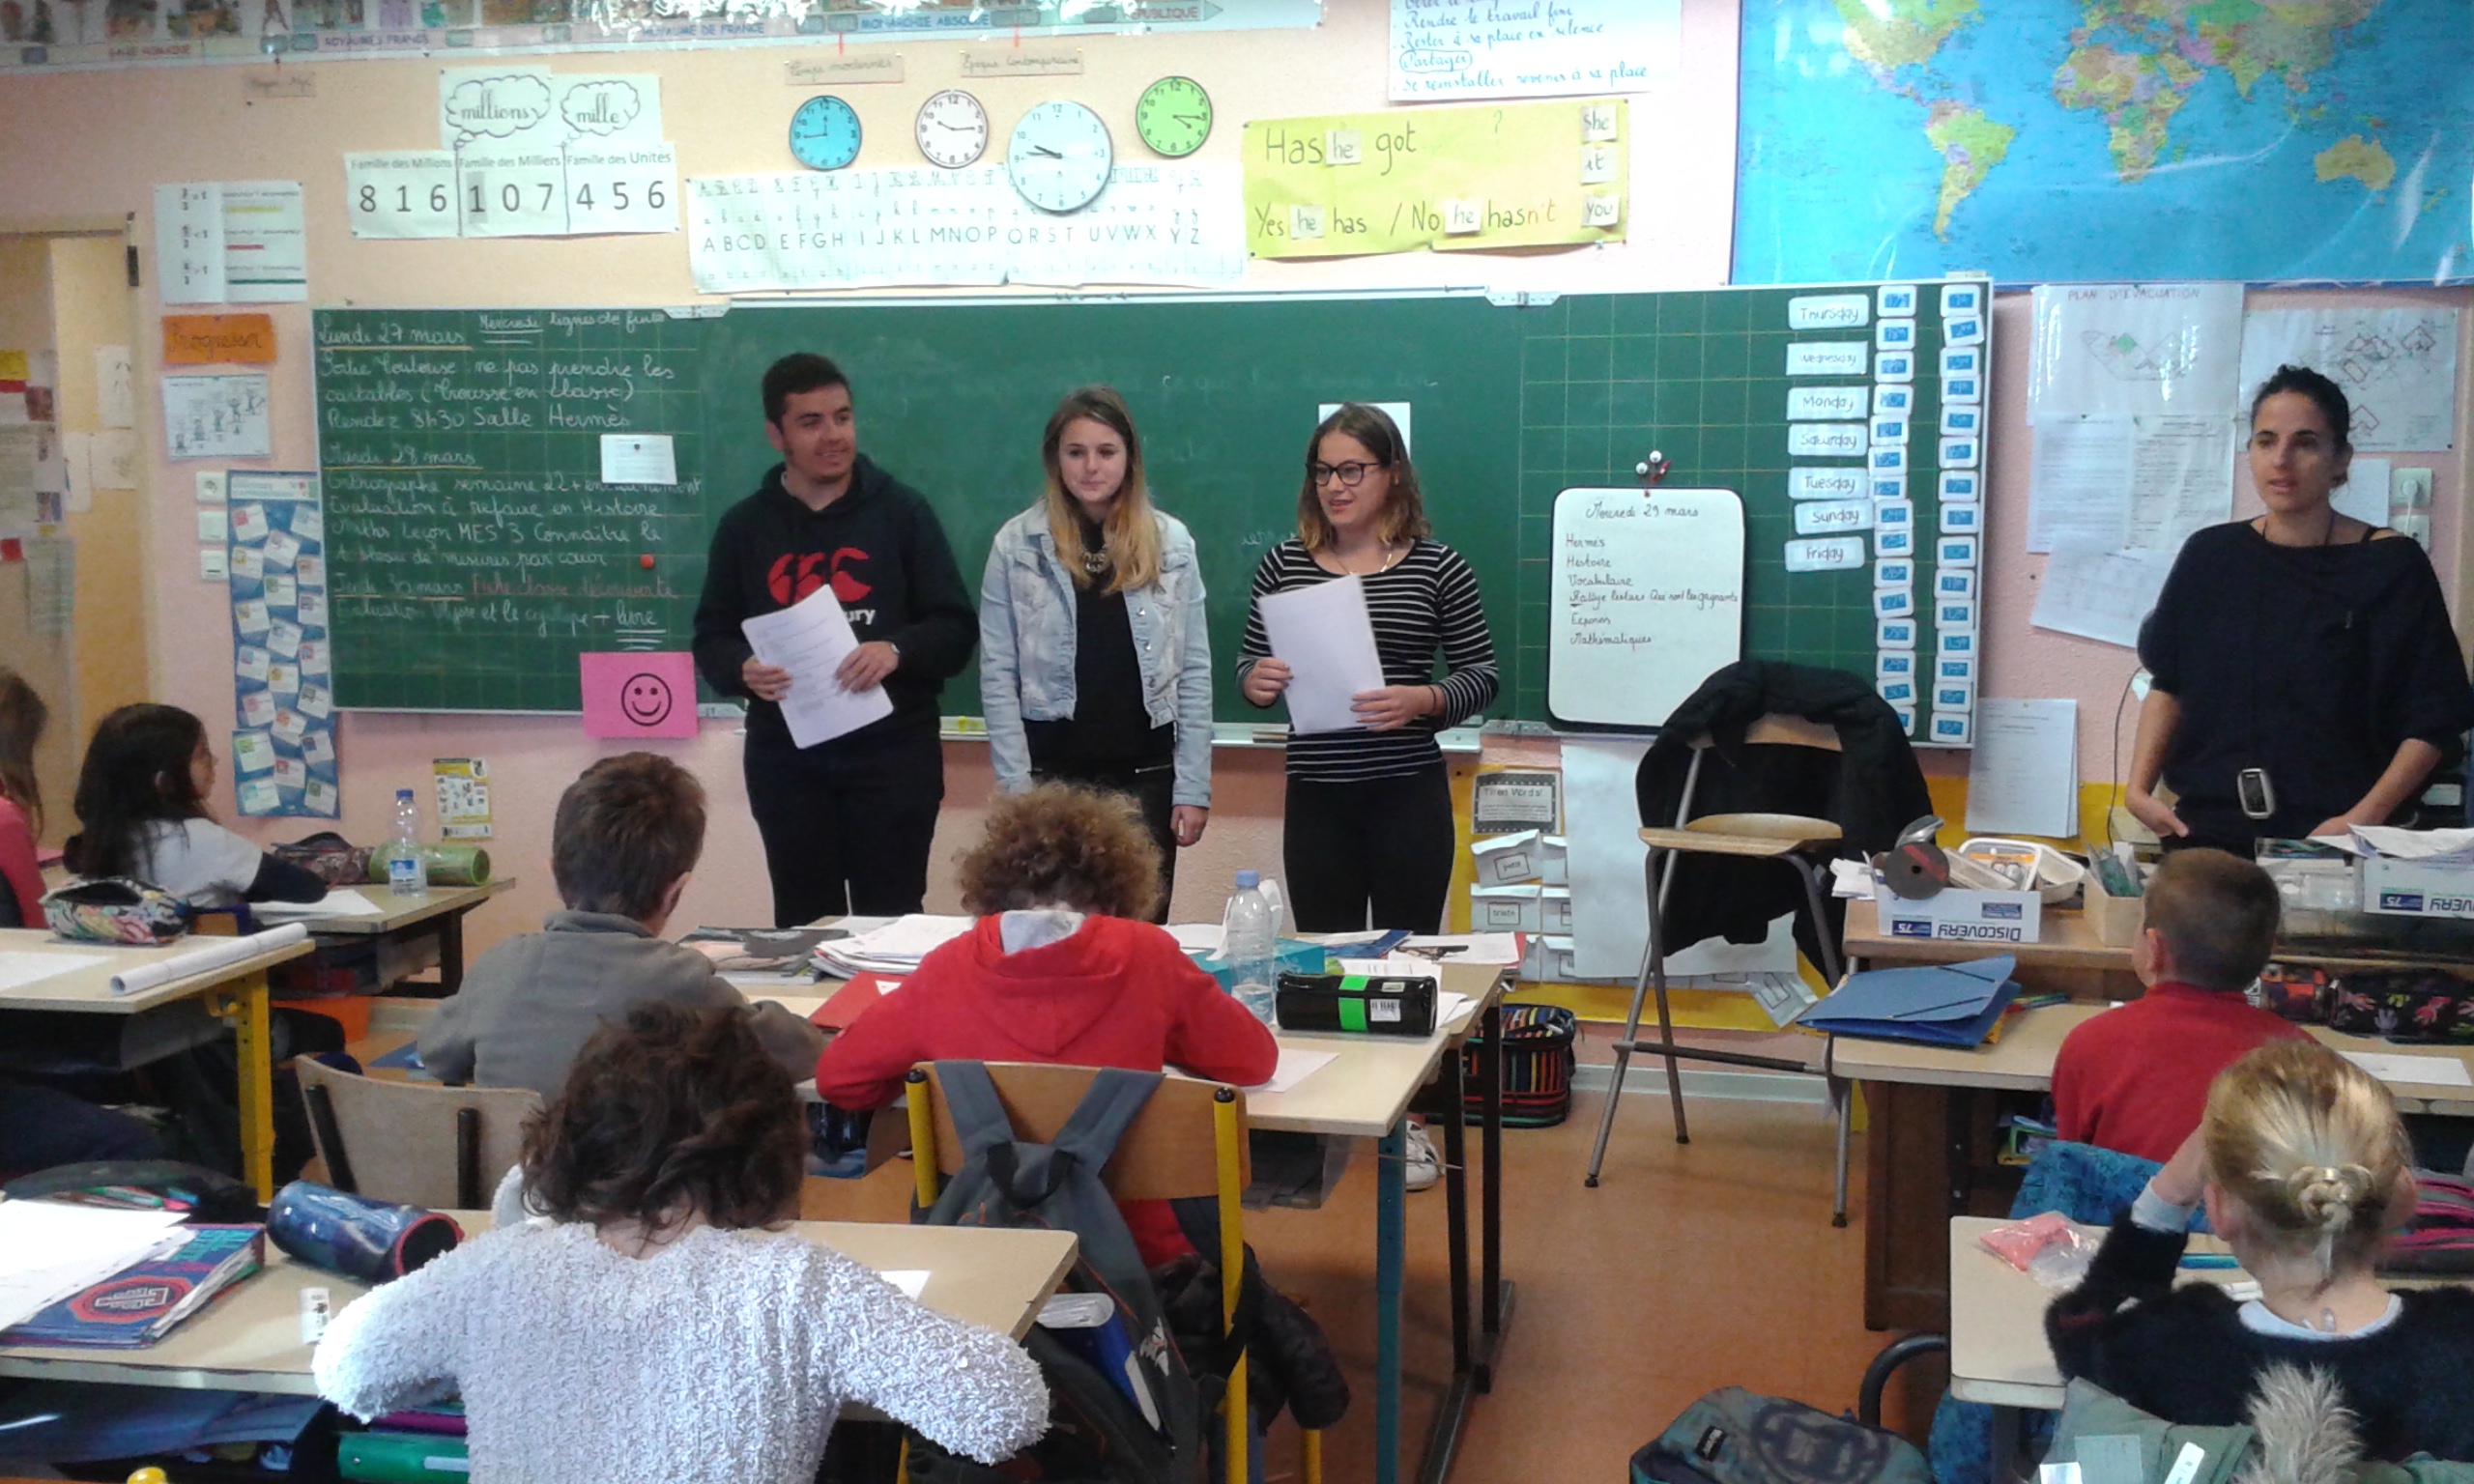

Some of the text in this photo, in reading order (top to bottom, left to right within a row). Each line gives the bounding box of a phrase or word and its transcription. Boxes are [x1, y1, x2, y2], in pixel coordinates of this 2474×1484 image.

[461, 90, 531, 122] millions
[576, 93, 620, 125] mille
[1583, 111, 1611, 132] she
[1264, 127, 1324, 166] Has
[1332, 138, 1354, 160] he
[1375, 126, 1418, 176] got
[1584, 151, 1606, 172] it
[1585, 200, 1614, 221] you
[1254, 205, 1286, 239] Yes
[1296, 212, 1318, 234] he
[1333, 207, 1368, 235] has
[1411, 203, 1441, 233] No
[1453, 204, 1476, 227] he
[409, 328, 466, 344] mars
[1803, 395, 1854, 413] Monday
[1804, 475, 1856, 494] Tuesday
[1643, 503, 1659, 517] 29
[1811, 509, 1859, 525] Sunday
[458, 523, 499, 543] MES
[1806, 546, 1844, 563] Friday
